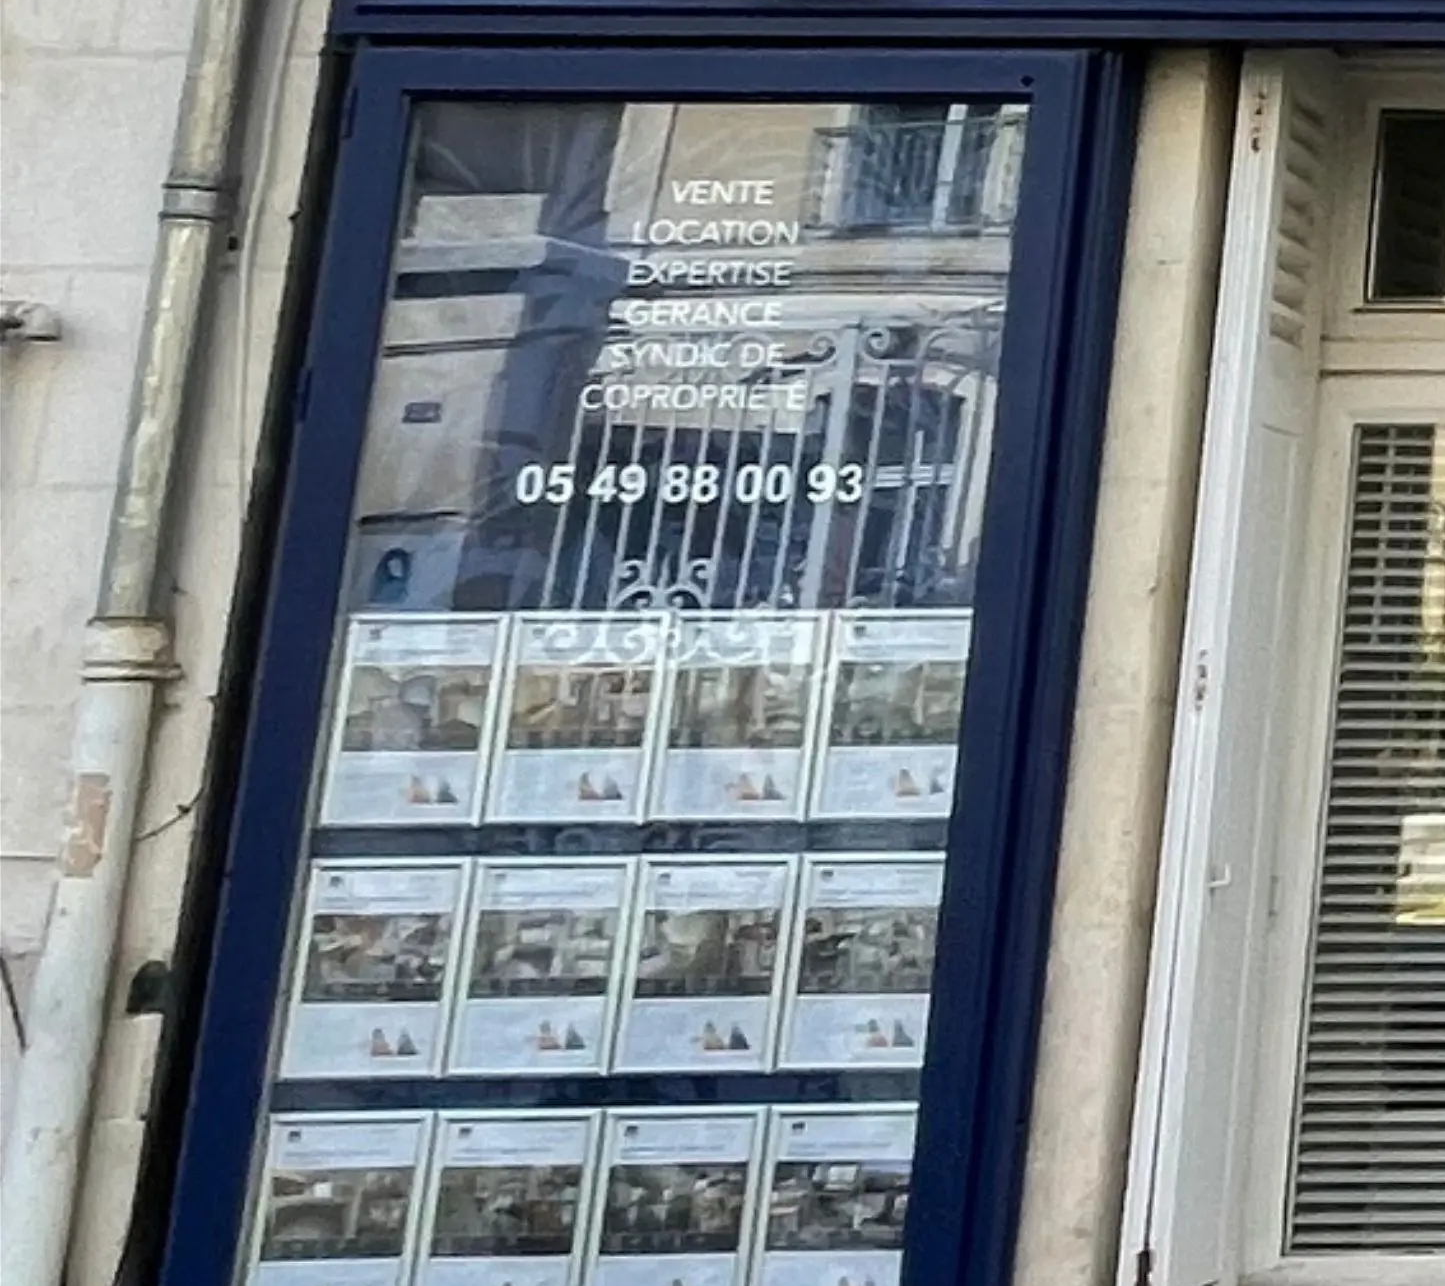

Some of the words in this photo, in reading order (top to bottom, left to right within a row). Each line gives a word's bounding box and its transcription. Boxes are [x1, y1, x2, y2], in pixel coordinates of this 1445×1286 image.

[671, 180, 774, 204] VENTE
[631, 219, 799, 245] LOCATION
[627, 261, 794, 286] EXPERTISE
[611, 342, 732, 368] SYNDIC
[740, 342, 786, 368] DE
[516, 465, 575, 504] 05
[586, 465, 648, 504] 49
[662, 465, 720, 504] 88
[735, 465, 791, 504] 00
[806, 465, 864, 504] 93
